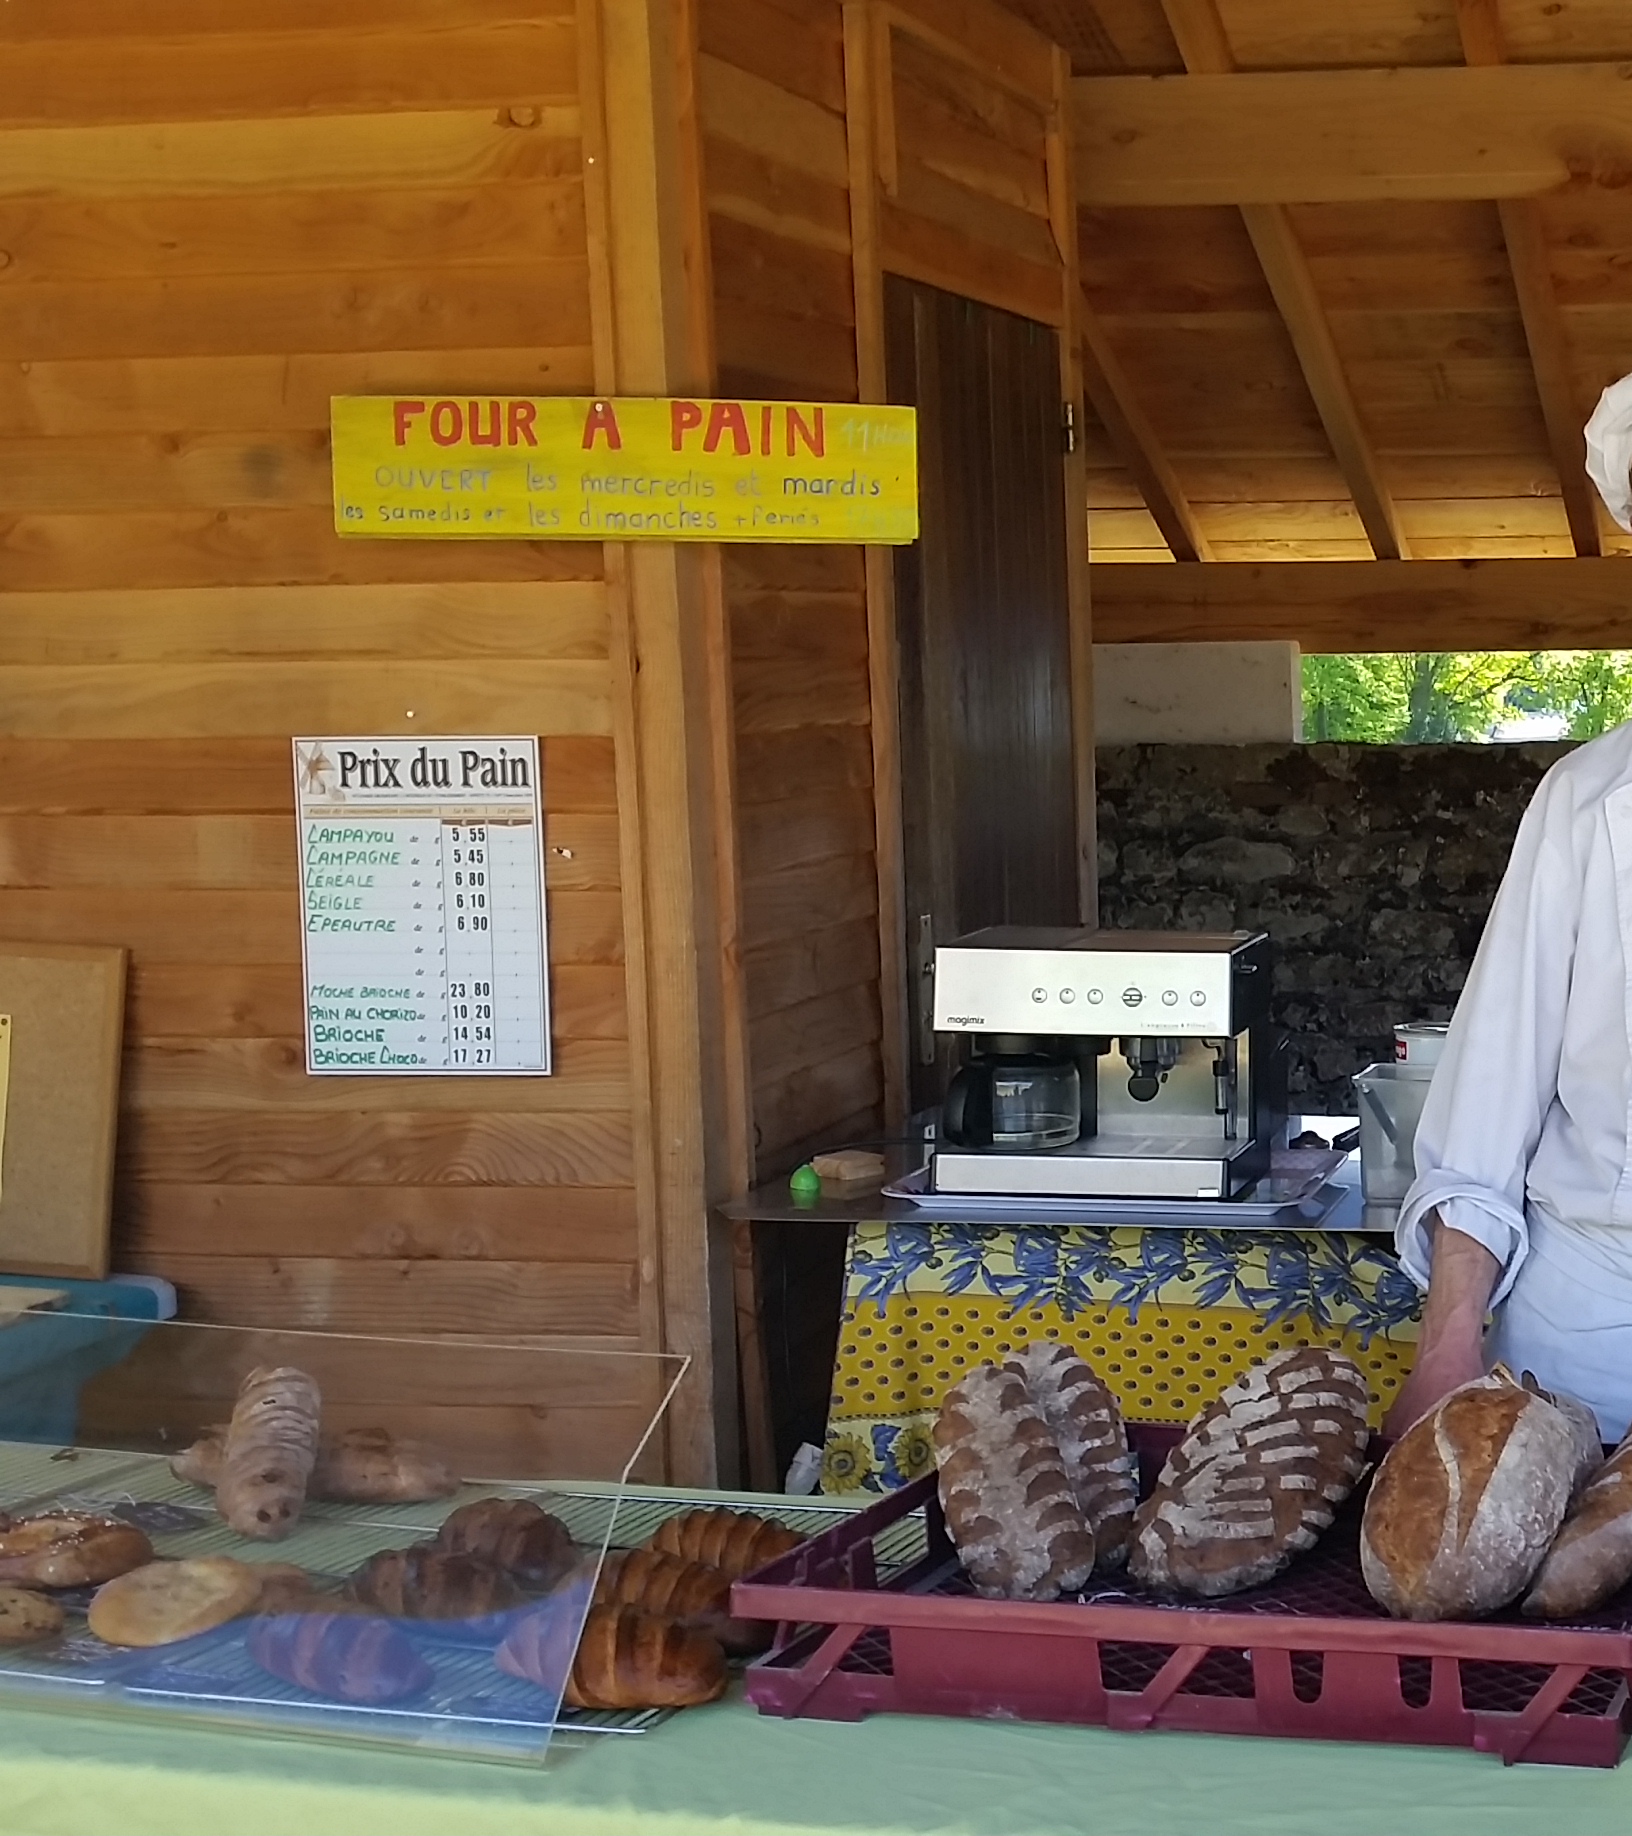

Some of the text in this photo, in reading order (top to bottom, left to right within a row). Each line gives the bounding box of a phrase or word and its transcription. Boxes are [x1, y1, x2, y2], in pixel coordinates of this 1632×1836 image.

[393, 401, 538, 448] FOUR
[670, 401, 824, 458] PAIN
[376, 463, 880, 498] OUVERT les mercredis et mardis
[341, 498, 364, 520] les
[379, 501, 470, 522] samedis
[528, 501, 560, 527] les
[579, 499, 717, 530] dimanches
[337, 746, 533, 788] Prix du Pain
[307, 914, 396, 933] EPEAUTRE
[947, 1015, 985, 1027] magimix
